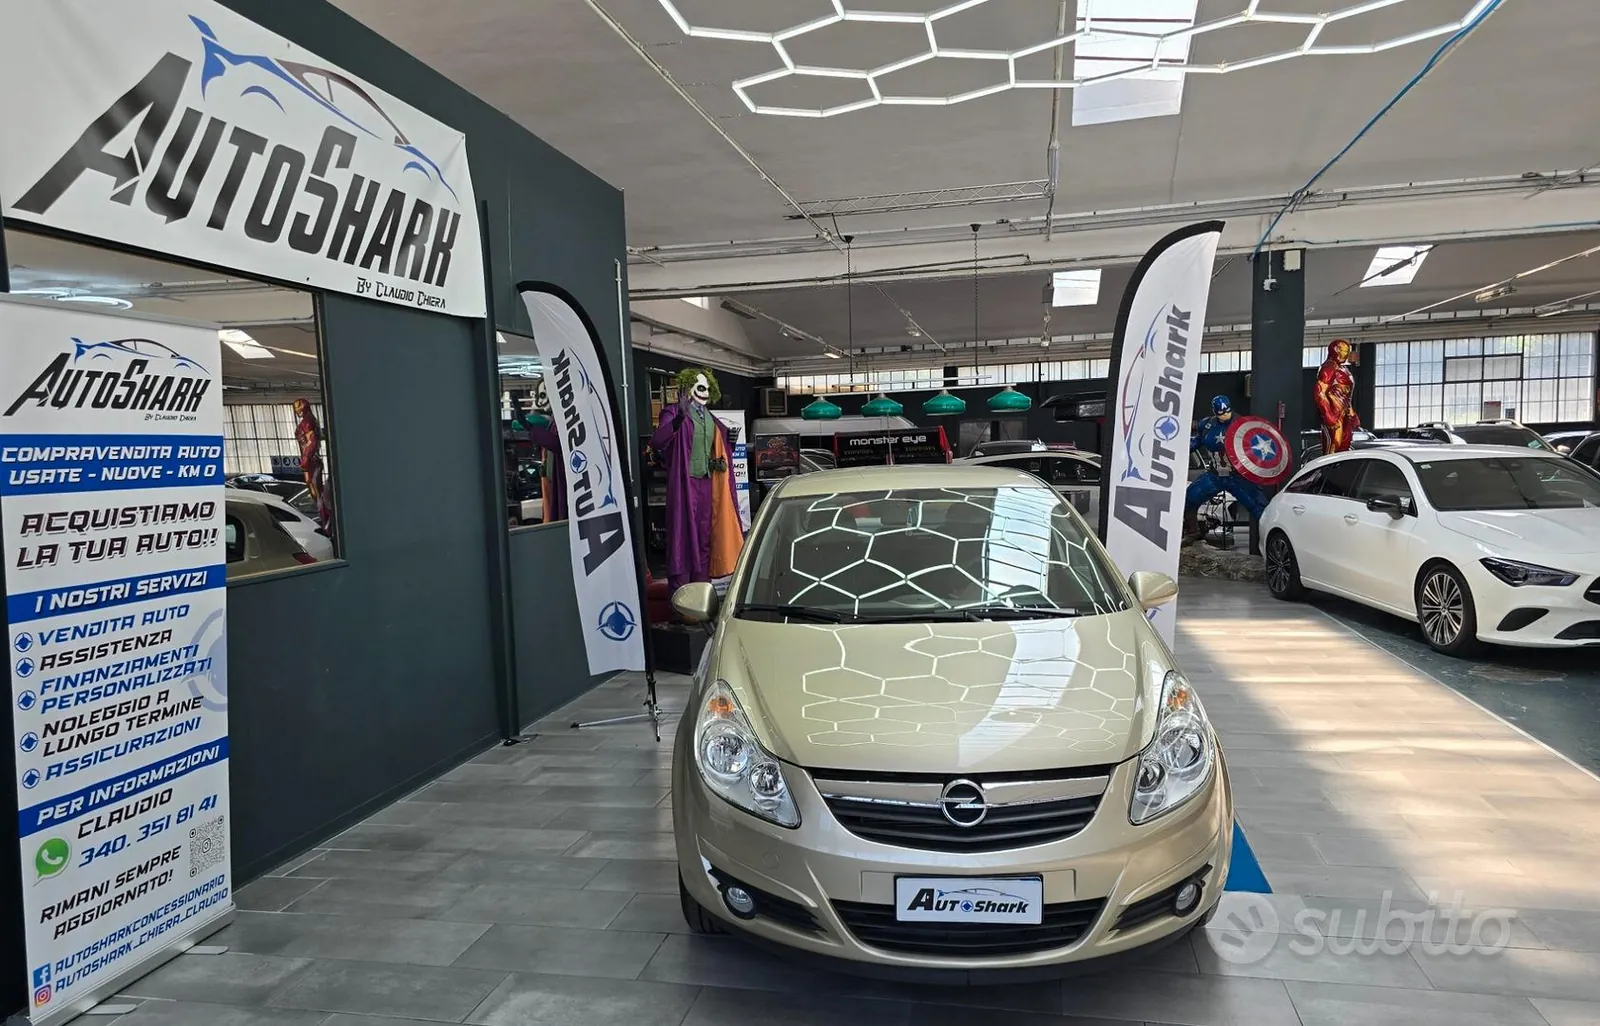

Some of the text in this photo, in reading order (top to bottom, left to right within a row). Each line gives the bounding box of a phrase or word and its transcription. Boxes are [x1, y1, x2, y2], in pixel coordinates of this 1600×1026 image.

[1, 446, 221, 463] COMPRAVENDITA AUTO
[849, 435, 927, 446] monster eye
[9, 468, 82, 486] USATE
[101, 465, 162, 482] NUOVE
[178, 465, 201, 478] KM
[20, 501, 216, 535] ACQUISTIAMO
[16, 528, 219, 569] LA TUA AUTO!!
[35, 570, 208, 613] I NOSTRI SERVIZI
[38, 604, 190, 646] VENDITA AUTO
[40, 629, 172, 671] ASSISTENZA
[40, 644, 199, 696] FINANZIAMENTI
[41, 657, 212, 715] PERSONALIZZATI
[42, 689, 170, 739] NOLEGGIO A
[43, 696, 204, 757] LUNGO TERMINE
[45, 717, 202, 781] ASSICURAZIONI
[37, 745, 220, 826] PER INFORMAZIONI
[77, 788, 173, 839] CLAUDIO
[137, 814, 172, 842] 351
[176, 806, 194, 825] 81
[198, 794, 218, 812] 41
[40, 845, 182, 924] RIMANI SEMPRE
[53, 869, 174, 940] AGGIORNATO!
[55, 874, 225, 975] AUTOSHARKCONCESSIONARIO
